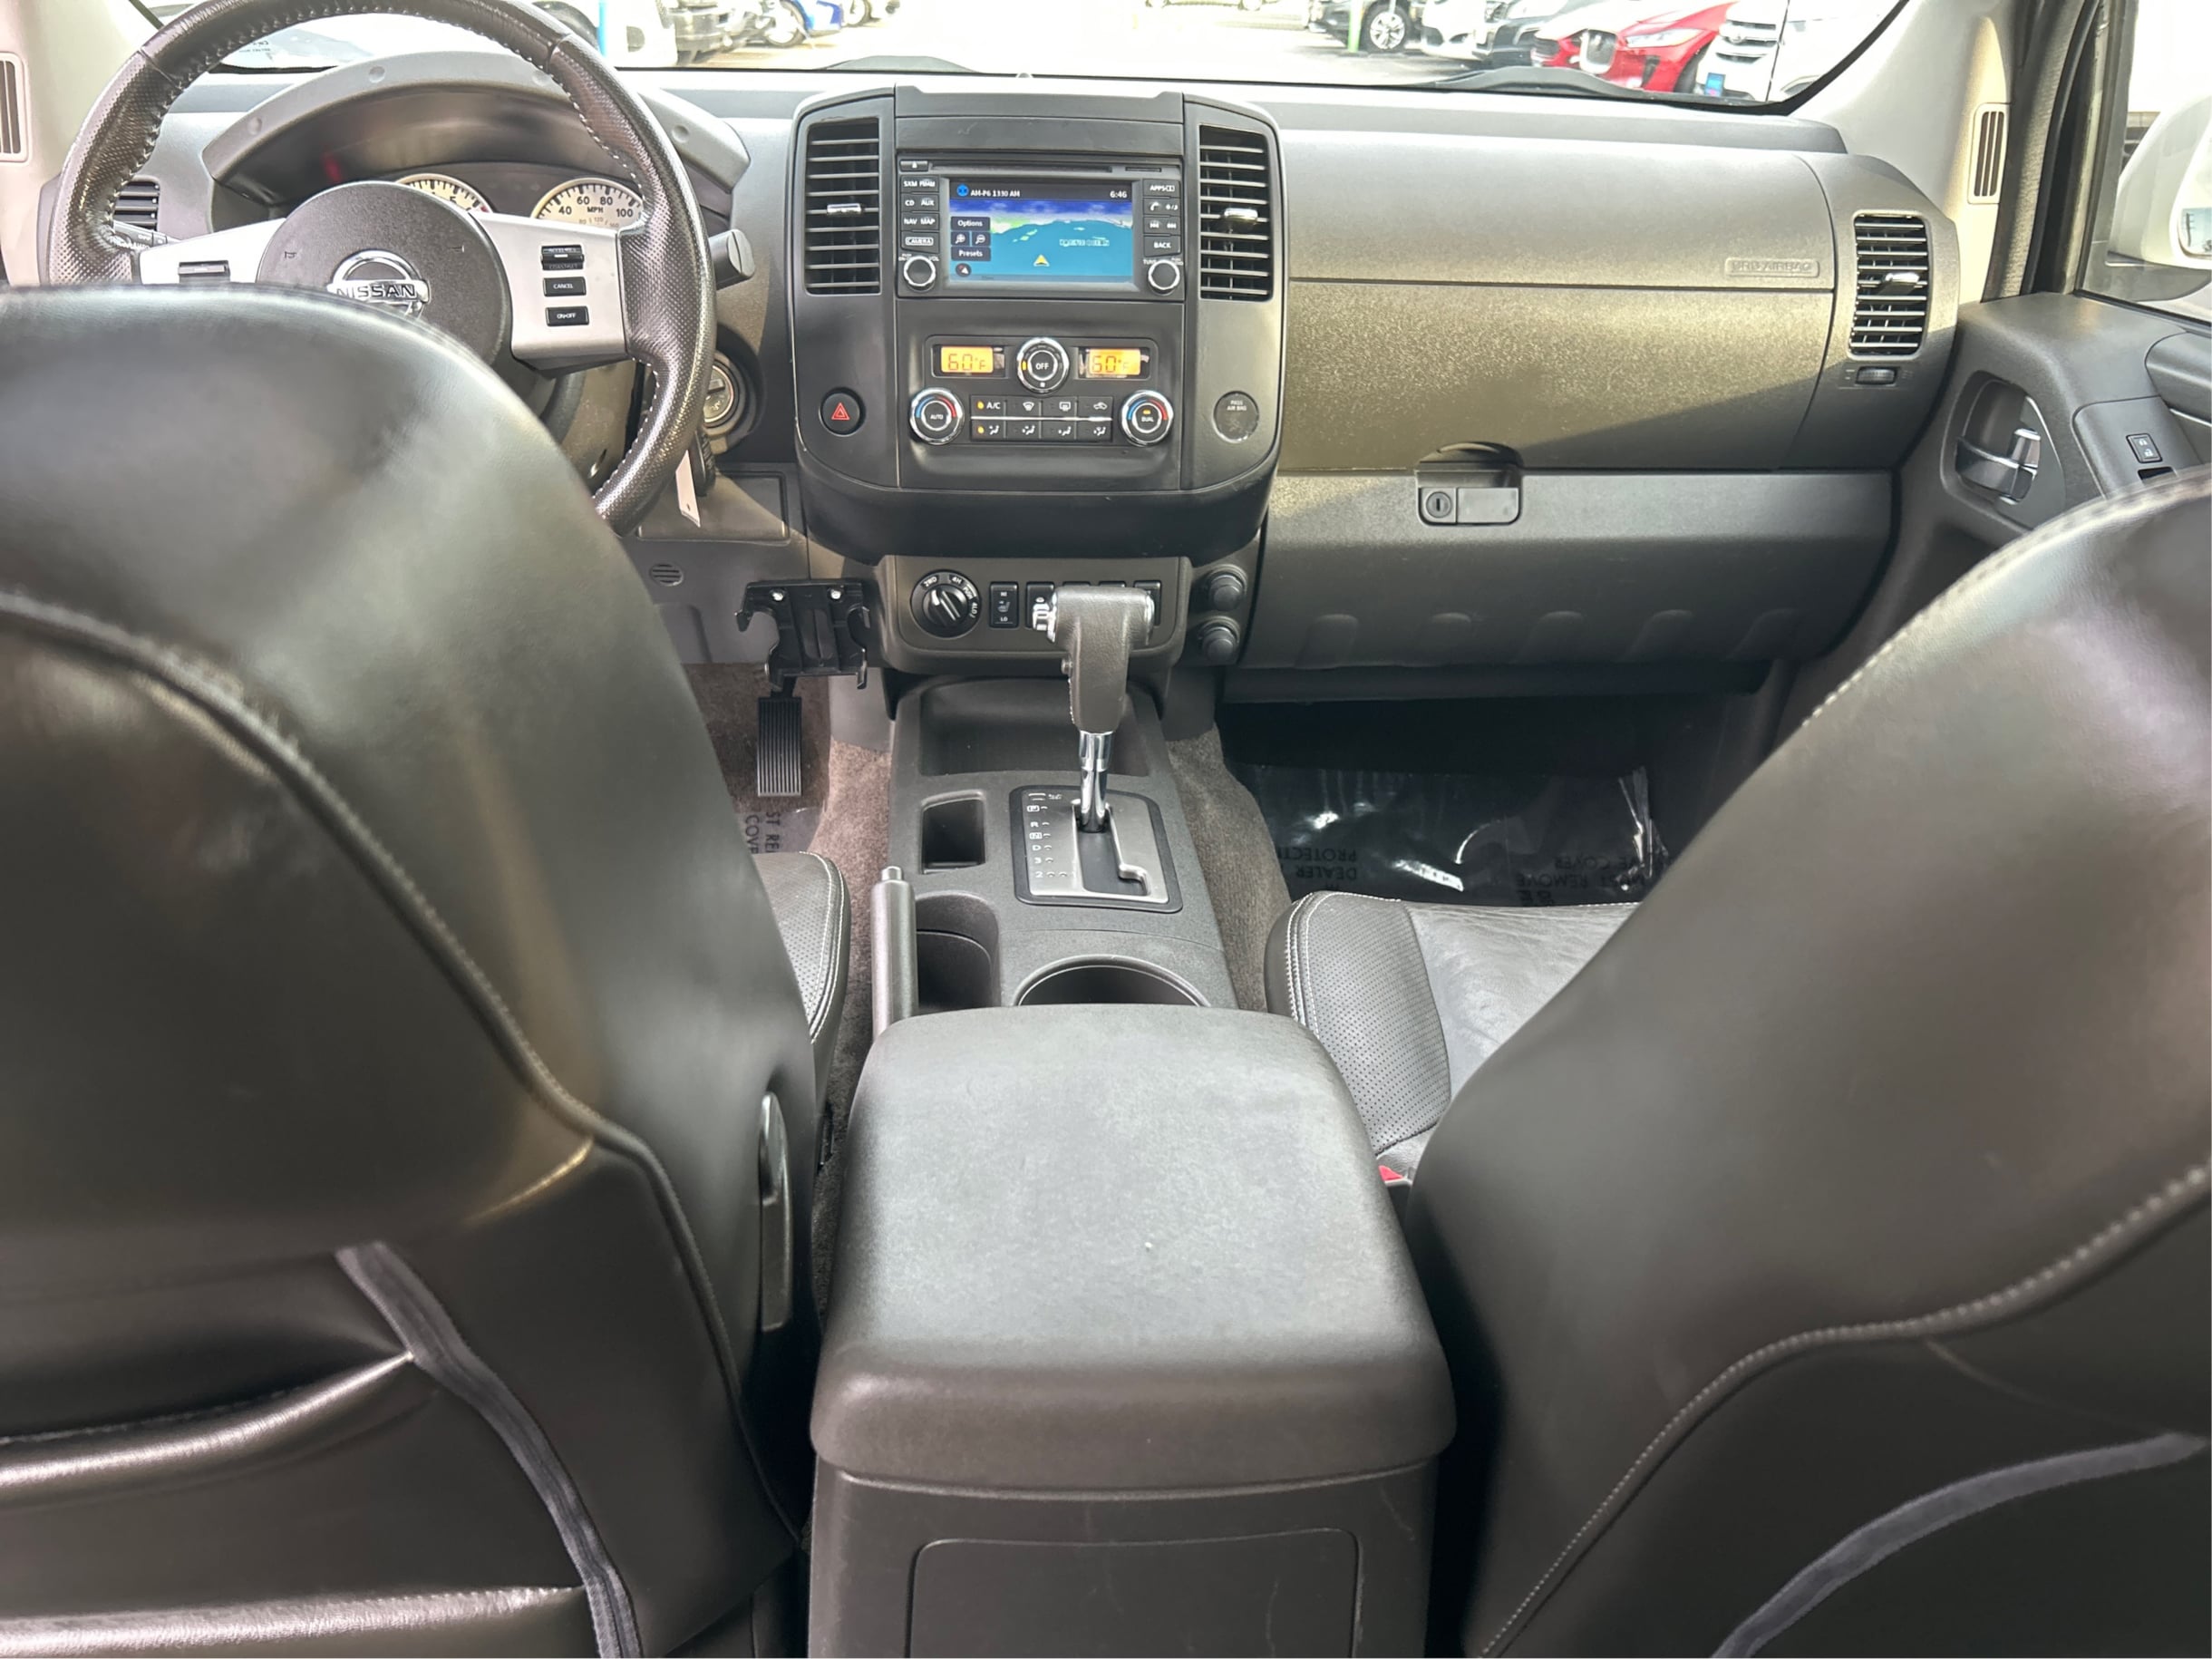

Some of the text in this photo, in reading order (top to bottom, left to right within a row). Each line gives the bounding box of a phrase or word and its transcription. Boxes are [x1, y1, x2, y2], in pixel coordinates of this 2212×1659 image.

[1110, 190, 1127, 199] 6:46
[577, 196, 590, 205] 60
[599, 196, 613, 206] 80
[558, 206, 572, 215] 40
[616, 209, 634, 218] 100
[957, 219, 983, 228] Options
[336, 284, 416, 298] NISSAN
[1295, 865, 1357, 880] DEALER
